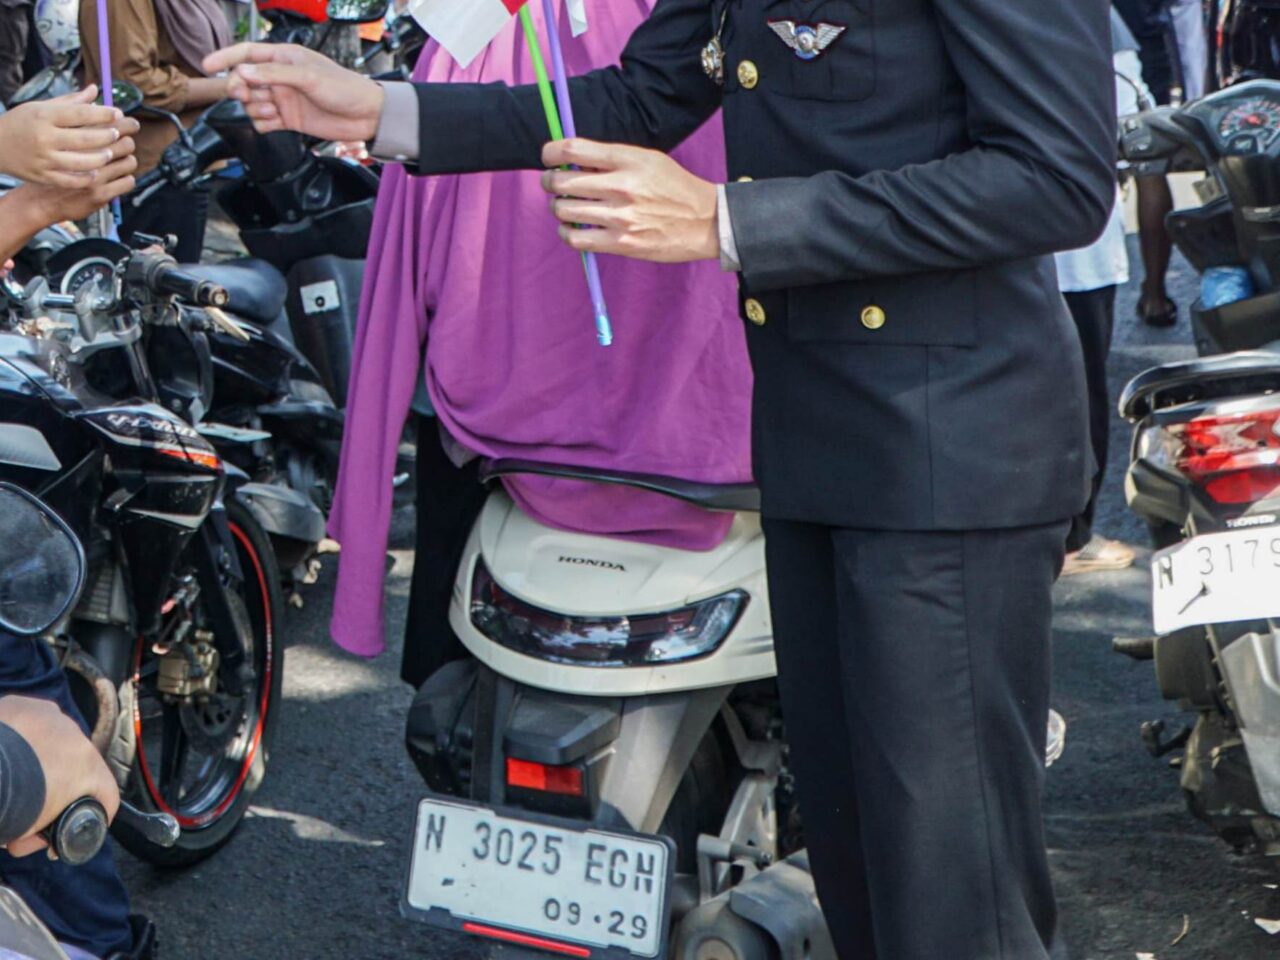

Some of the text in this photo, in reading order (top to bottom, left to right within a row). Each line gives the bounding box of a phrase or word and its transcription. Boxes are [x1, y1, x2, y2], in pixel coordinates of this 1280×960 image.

[558, 555, 627, 572] HONDA
[1158, 554, 1174, 590] N
[425, 813, 656, 894] N 3025 EGN
